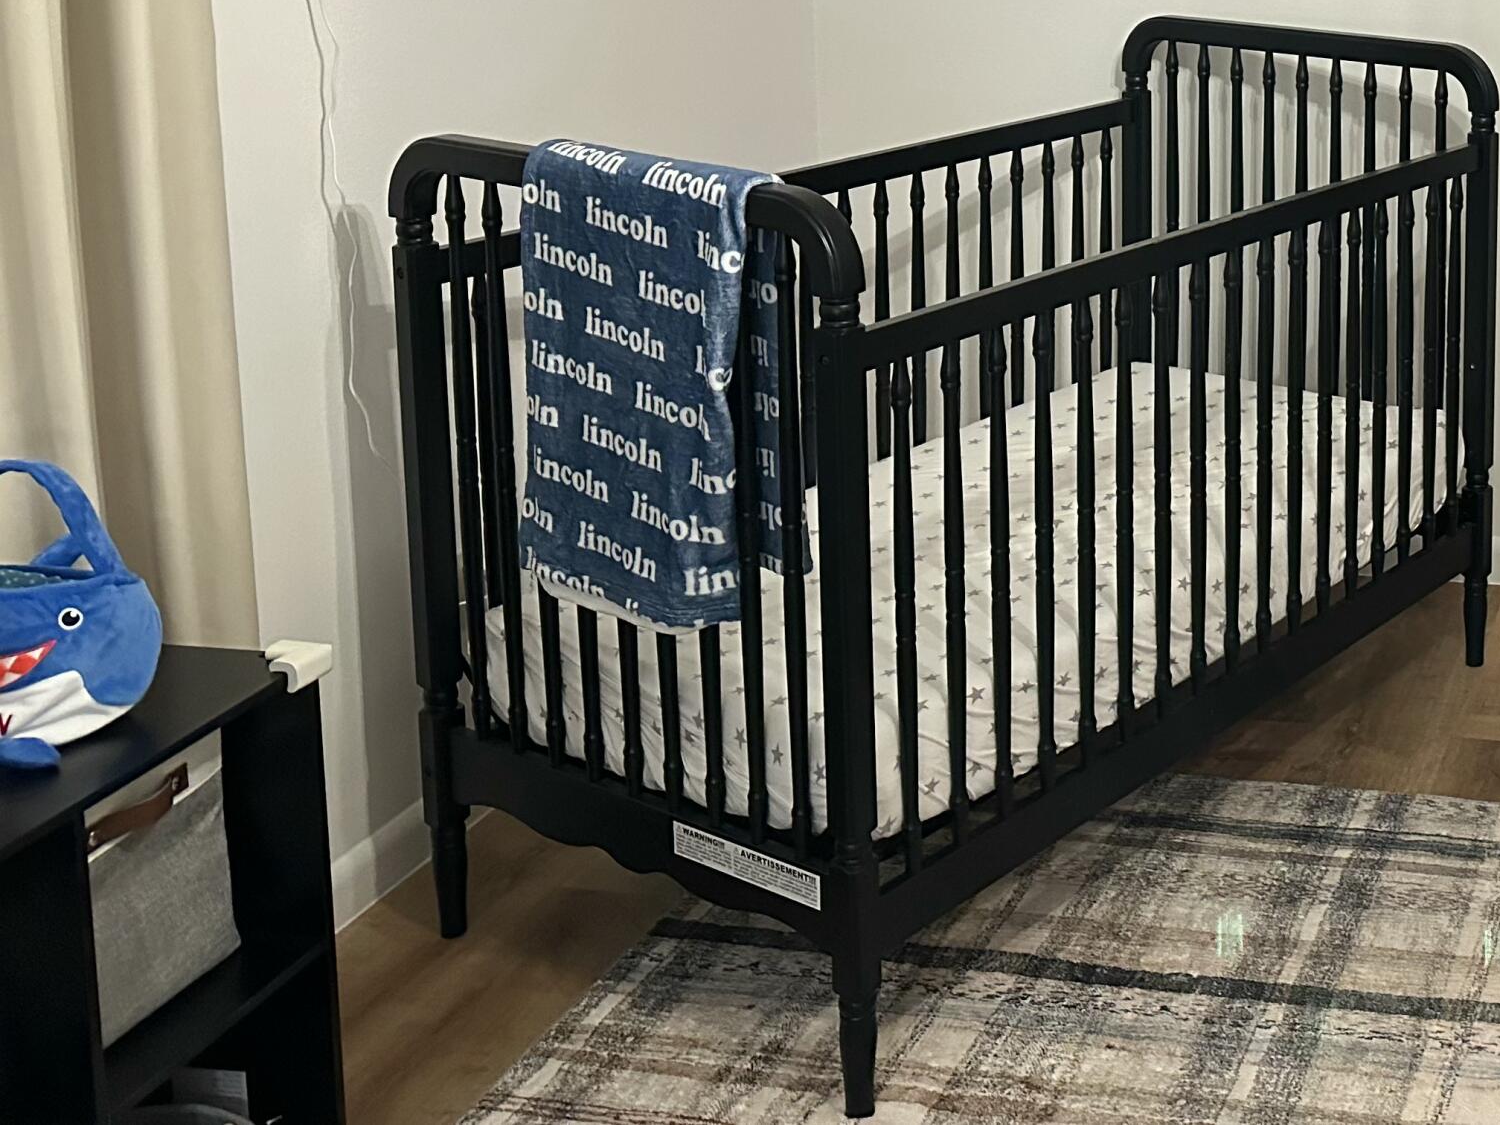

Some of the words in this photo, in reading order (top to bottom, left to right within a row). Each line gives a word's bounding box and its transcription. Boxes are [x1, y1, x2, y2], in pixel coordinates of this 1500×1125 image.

[547, 140, 627, 175] lincoln
[642, 161, 727, 208] lincoln
[585, 196, 668, 248] lincoln
[534, 232, 613, 286] lincoln
[584, 307, 666, 362] lincoln
[531, 339, 613, 395] lincoln
[582, 414, 662, 472] lincoln
[631, 490, 726, 545] lincoln
[577, 521, 656, 583] lincoln
